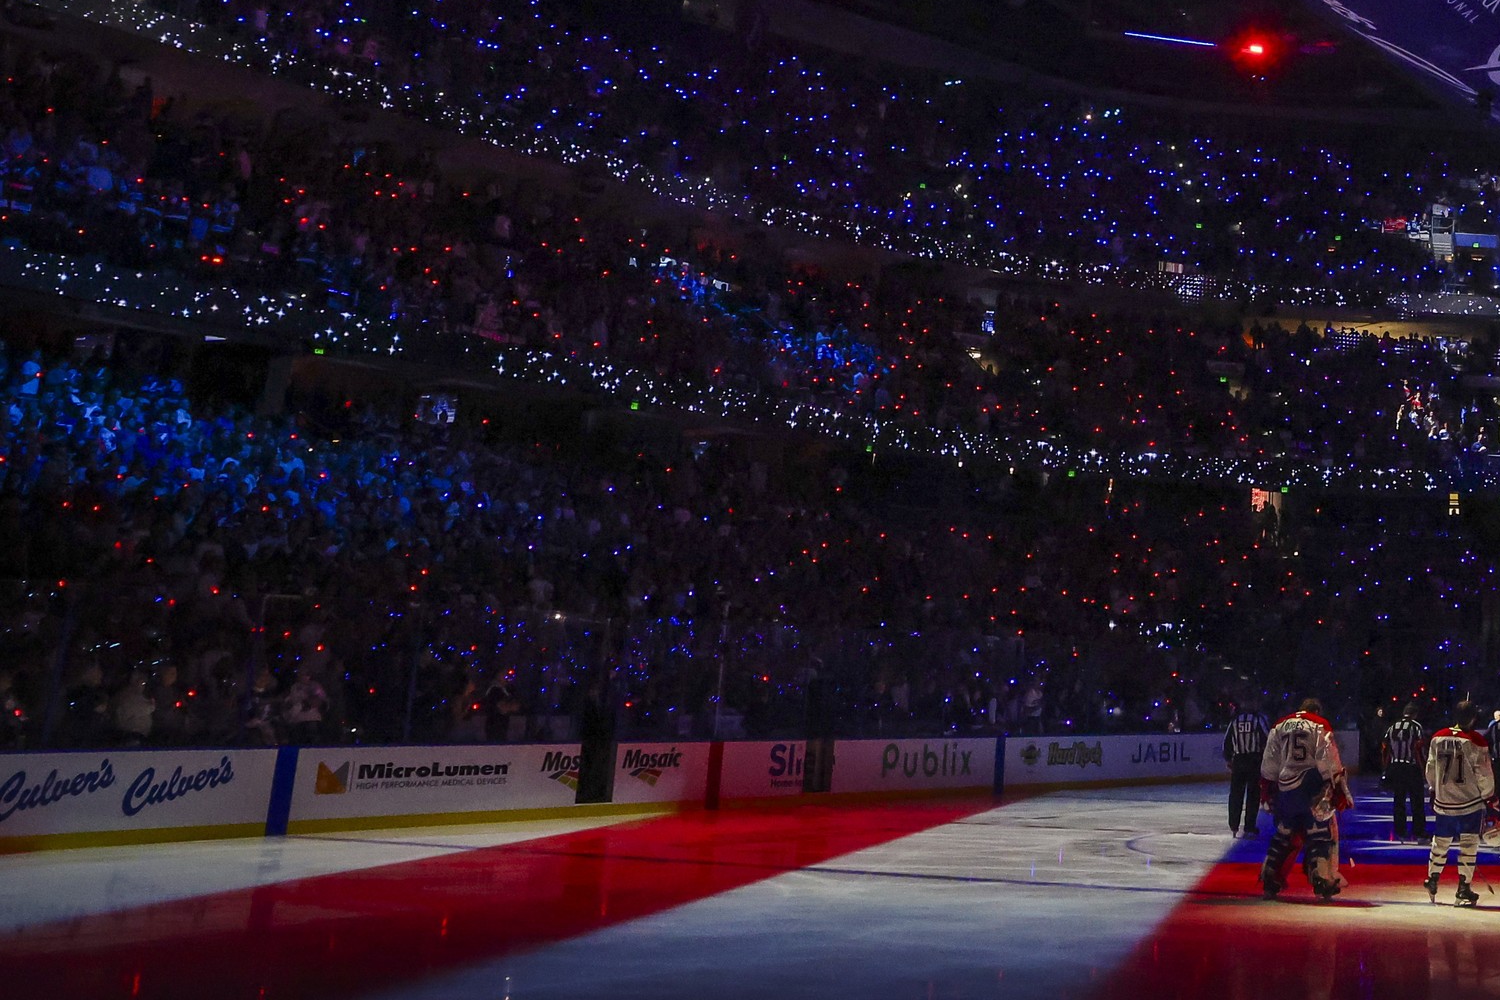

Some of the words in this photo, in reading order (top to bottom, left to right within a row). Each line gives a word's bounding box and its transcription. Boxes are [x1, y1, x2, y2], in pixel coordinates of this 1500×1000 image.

[1238, 721, 1252, 733] 50
[622, 747, 683, 769] Mosaic
[1047, 741, 1077, 765] Hard
[1131, 741, 1191, 764] JABIL
[1281, 733, 1307, 761] 75
[358, 762, 509, 780] MicroLumen
[541, 751, 582, 772] Mos
[882, 742, 972, 778] Publix
[1437, 752, 1466, 785] 71
[0, 758, 116, 823] Culver's
[122, 756, 235, 817] Culver's
[356, 781, 379, 790] HIGH
[380, 779, 439, 789] PERFORMANCE
[440, 777, 474, 787] MEDICAL
[476, 777, 508, 785] DEVICES
